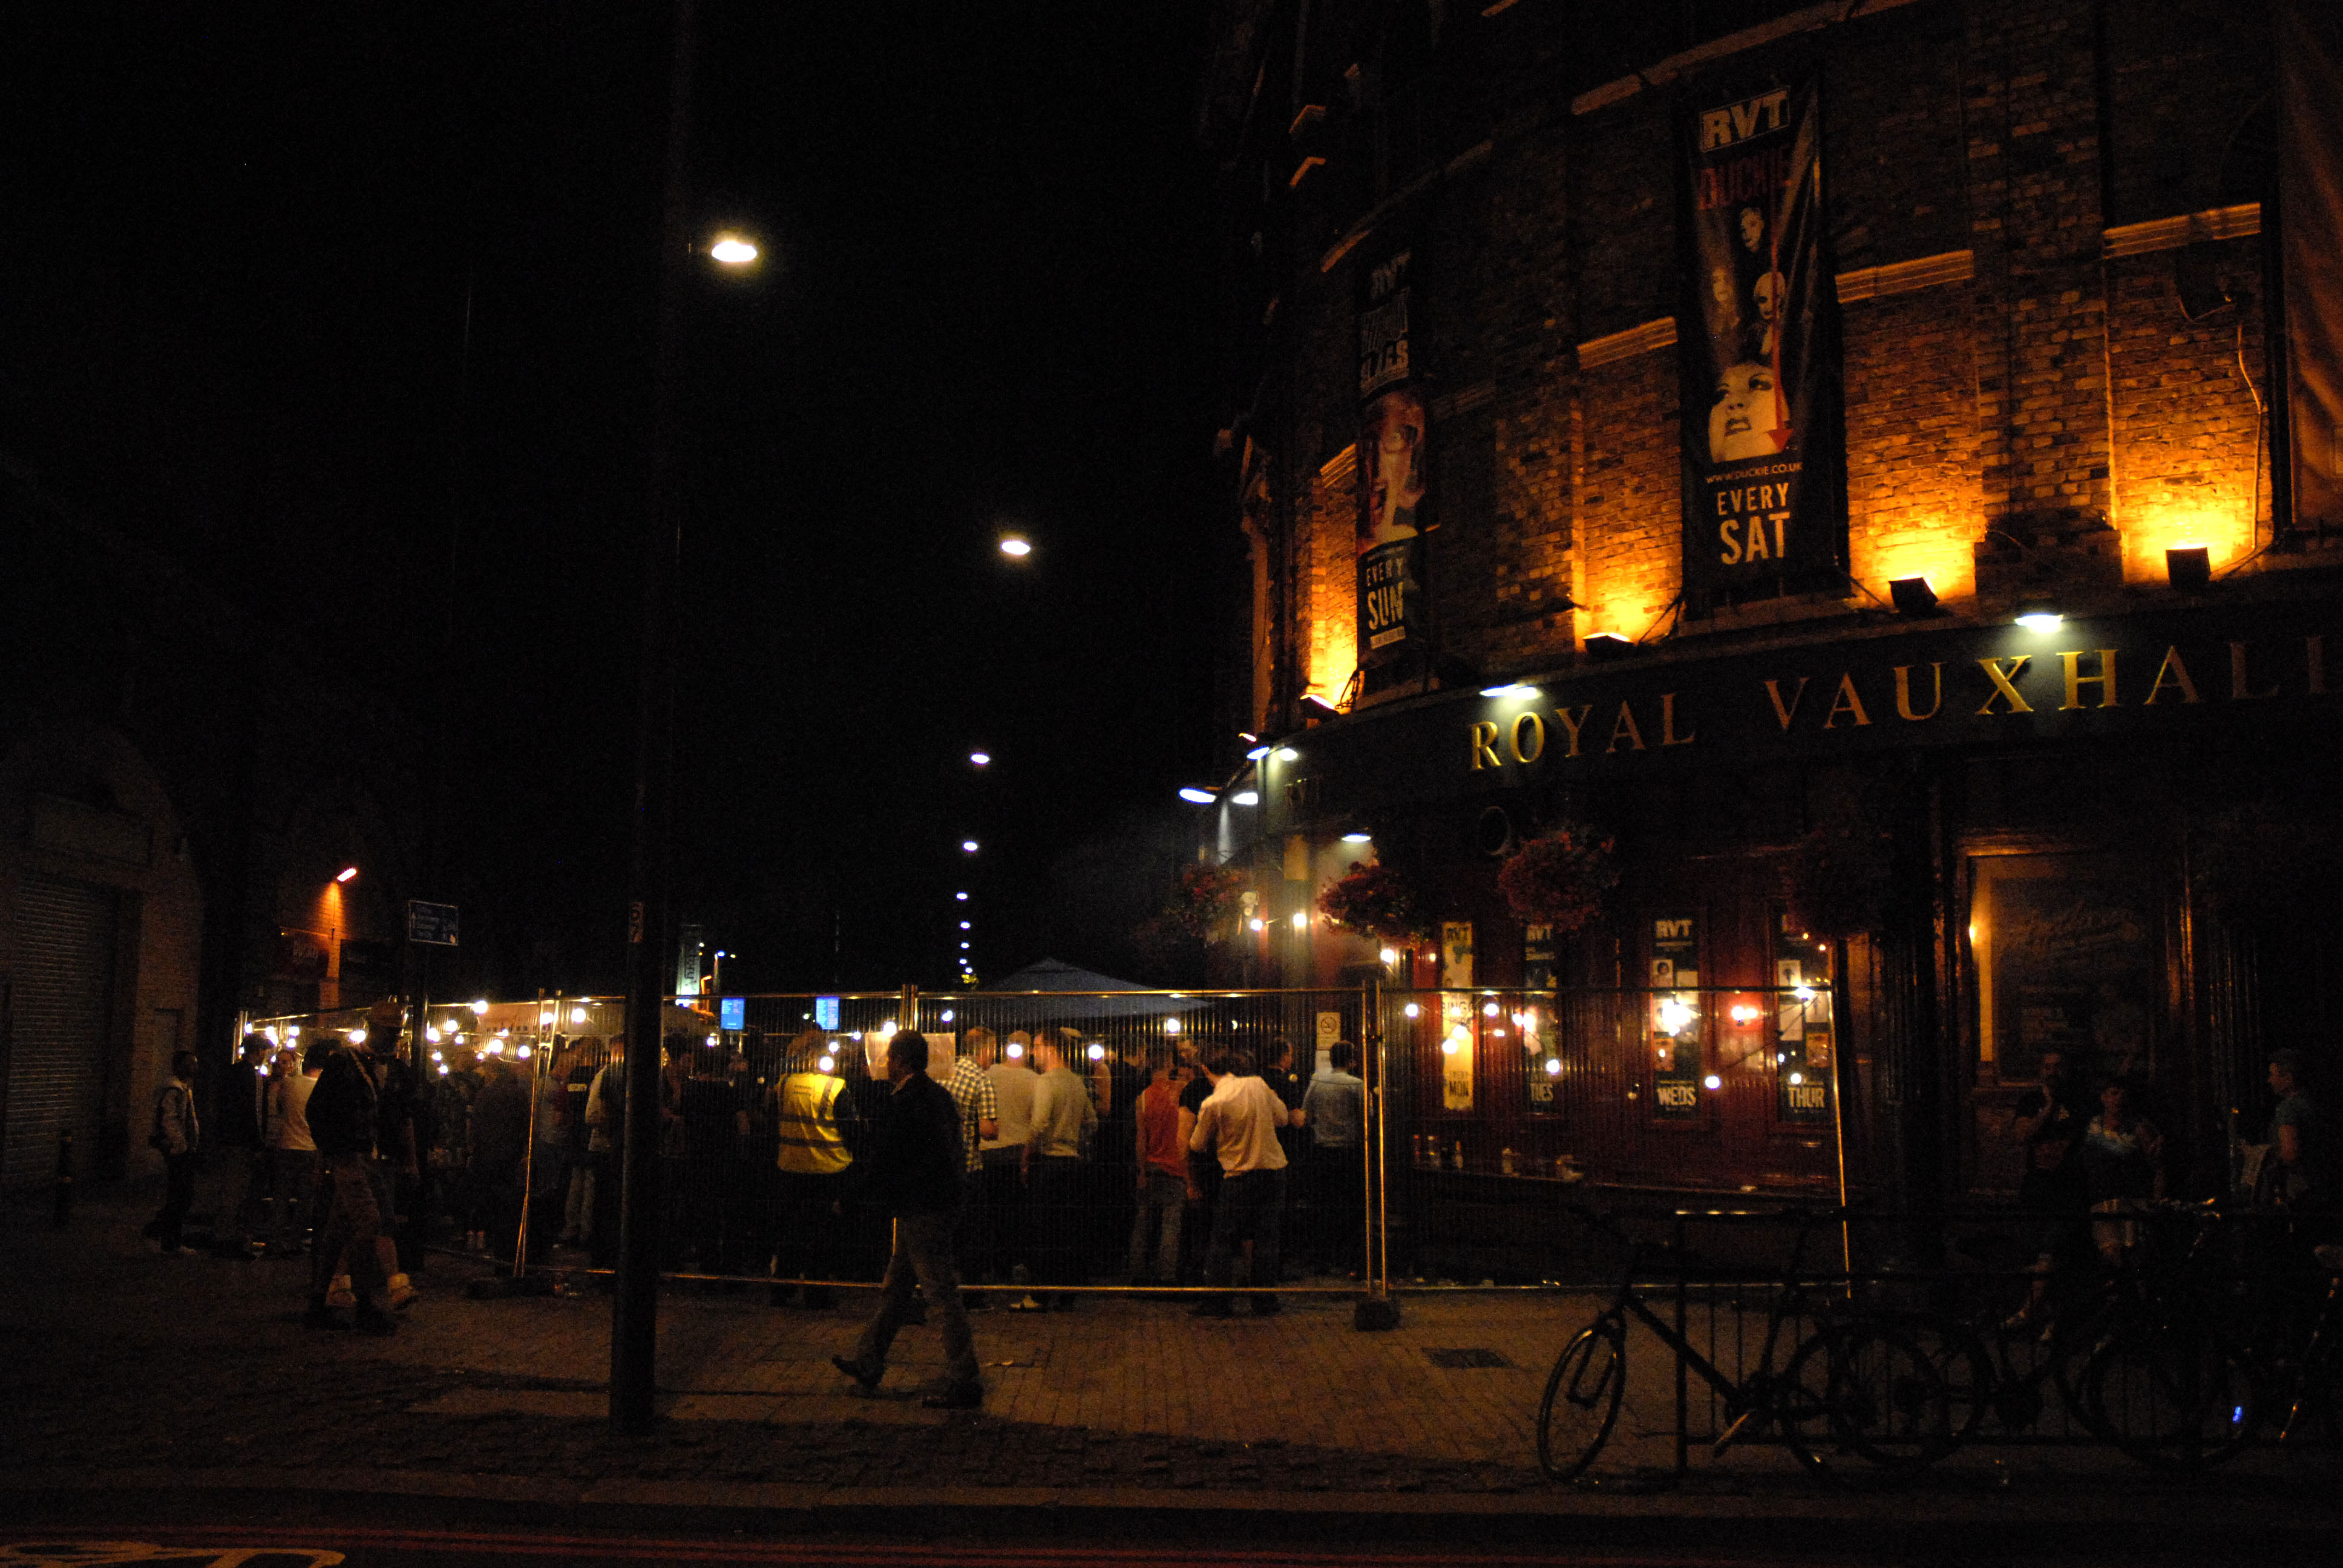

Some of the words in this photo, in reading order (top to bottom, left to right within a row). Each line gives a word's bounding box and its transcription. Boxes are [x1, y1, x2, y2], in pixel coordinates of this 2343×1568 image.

[1702, 90, 1787, 149] RVT
[1698, 146, 1791, 209] DUCKIE
[1705, 462, 1803, 483] WWW.DUCKIE.CO.UK
[1717, 482, 1789, 515] EVERY
[1719, 511, 1791, 564] SAT
[1366, 558, 1404, 587] EVERY
[1367, 581, 1404, 630] SUN
[1469, 692, 1696, 771] ROYAL
[1763, 635, 2341, 731] VAUXHALL
[1527, 923, 1553, 941] RVT
[1655, 918, 1693, 938] RVT
[1656, 1085, 1697, 1106] WEDS
[1787, 1086, 1825, 1108] THUR
